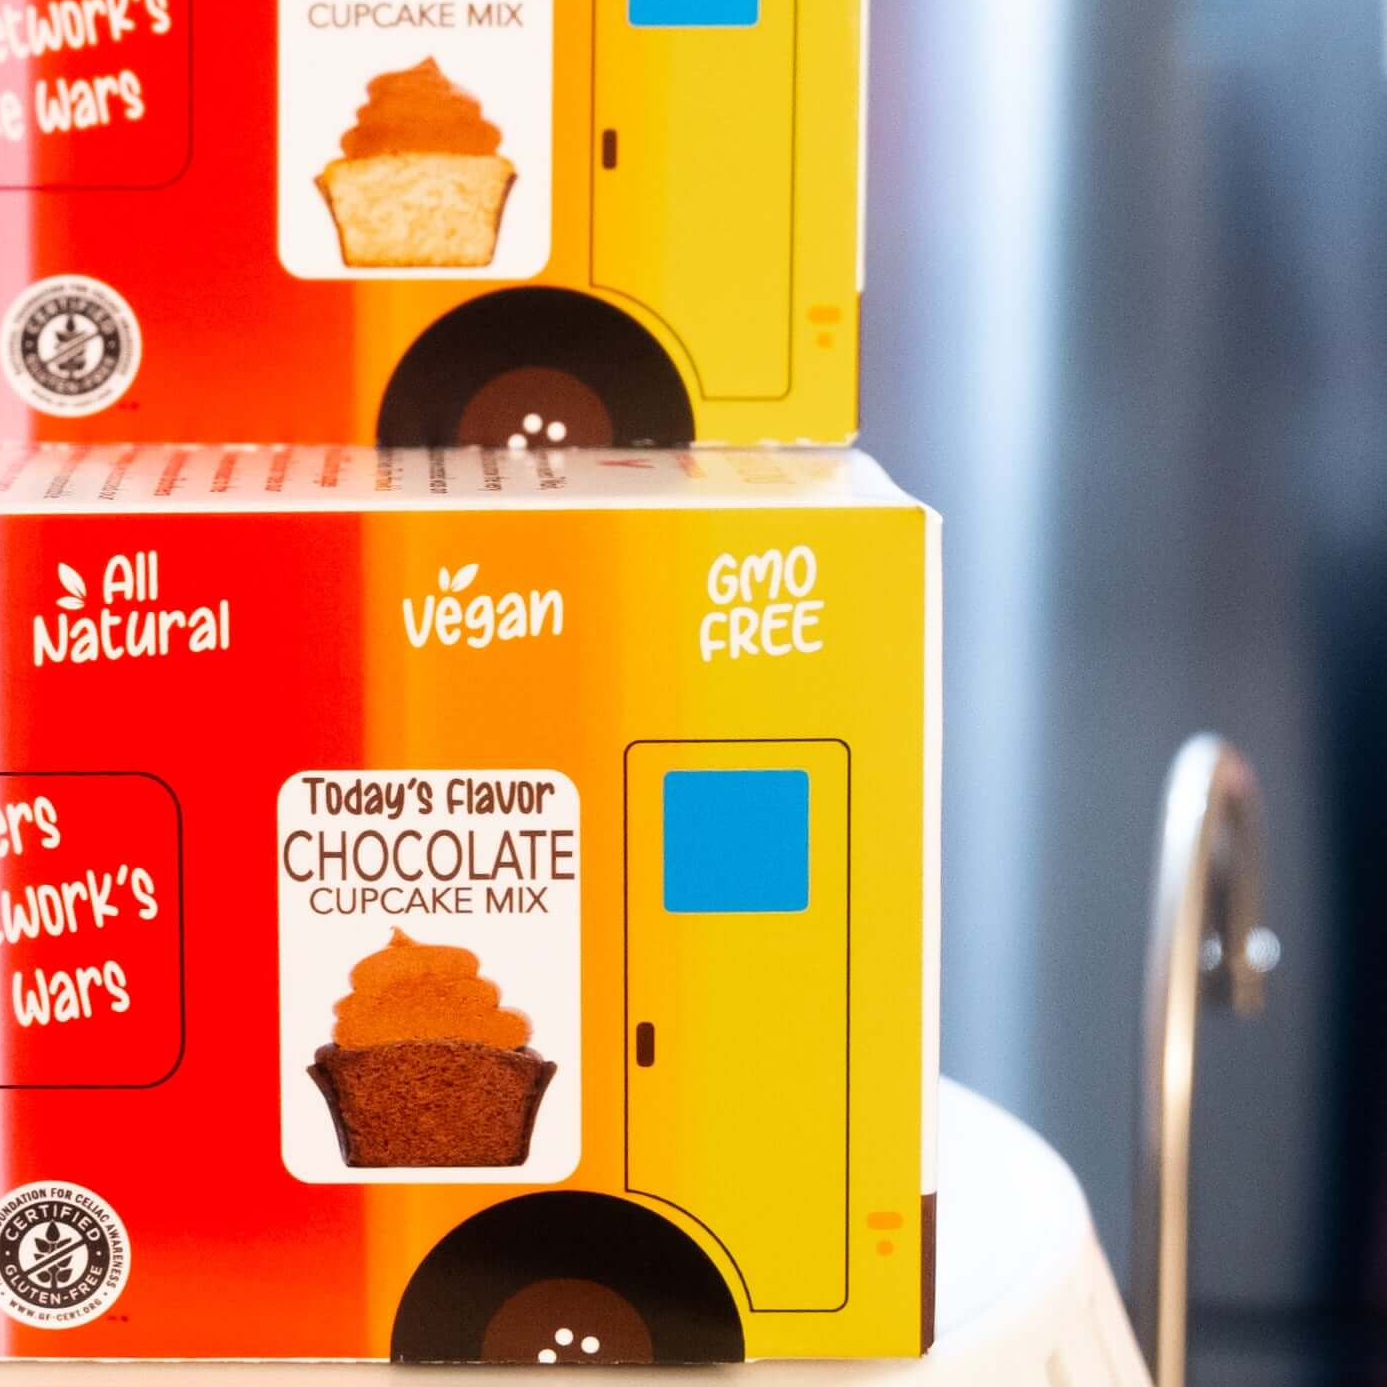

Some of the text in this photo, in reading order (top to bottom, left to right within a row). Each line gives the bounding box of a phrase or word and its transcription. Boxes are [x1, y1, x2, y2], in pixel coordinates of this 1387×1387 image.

[307, 3, 523, 28] CUPCAKE MIX
[35, 70, 145, 134] Wars
[103, 550, 158, 604] All
[707, 545, 817, 605] GMO
[33, 599, 230, 667] Natural
[403, 588, 564, 649] Vegan
[698, 600, 825, 663] FREE
[302, 777, 433, 820] Today's
[283, 829, 575, 882] CHOCOLATE
[309, 886, 549, 915] CUPCAKE MIX
[12, 961, 131, 1027] Wars
[5, 1204, 101, 1242] CERTIFIED
[50, 1187, 73, 1201] FOR
[75, 1194, 109, 1223] CELIAC
[106, 1224, 124, 1289] AWARENESS
[5, 1264, 103, 1305] GLUTEN-FREE
